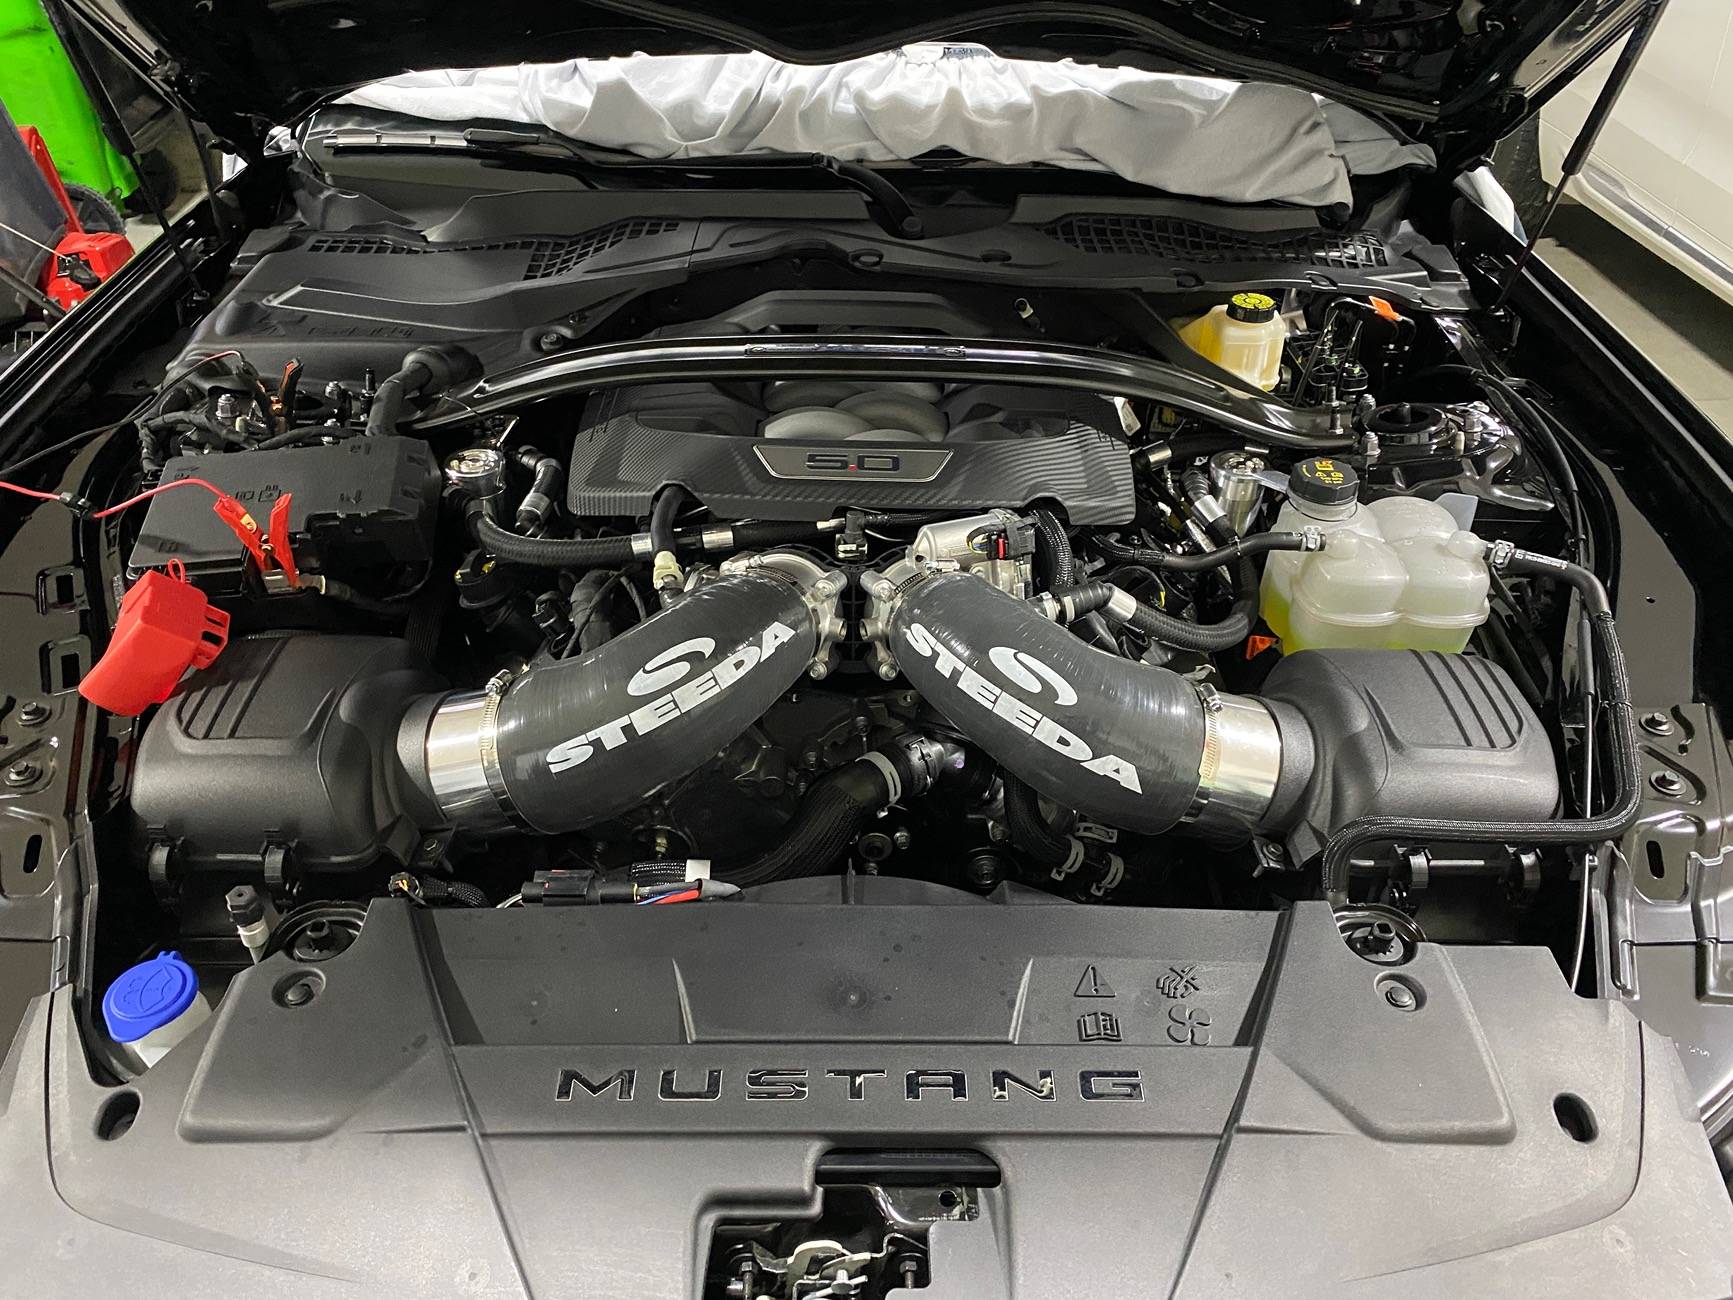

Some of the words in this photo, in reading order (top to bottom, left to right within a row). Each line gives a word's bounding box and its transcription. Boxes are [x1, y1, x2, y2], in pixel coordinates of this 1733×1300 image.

[804, 453, 901, 473] 5.0
[545, 621, 796, 774] STEEDA
[905, 622, 1143, 795] STEEDA
[554, 1068, 1146, 1103] MUSTANG
